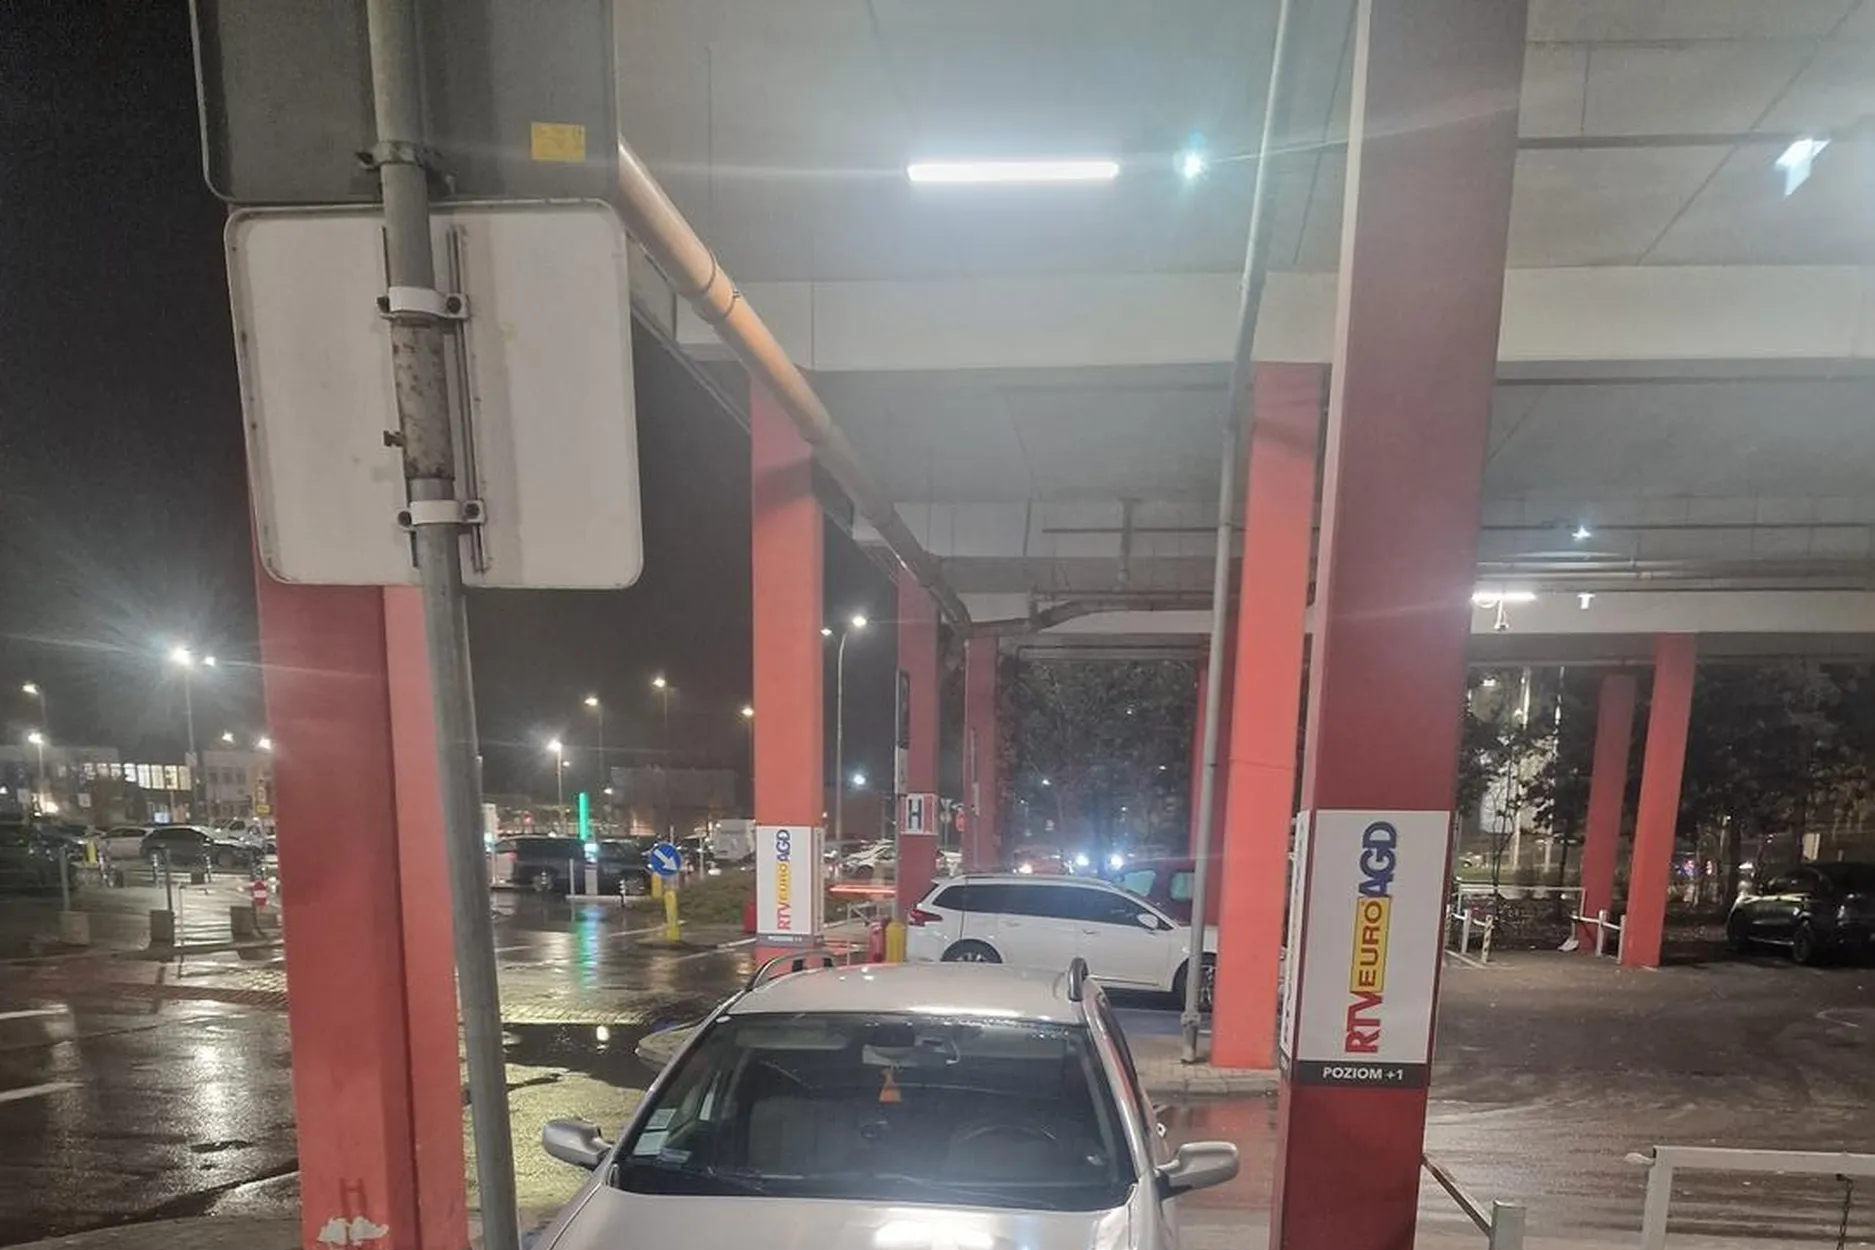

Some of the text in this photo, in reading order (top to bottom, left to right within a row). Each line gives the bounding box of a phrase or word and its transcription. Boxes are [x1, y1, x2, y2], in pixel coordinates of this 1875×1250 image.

[776, 829, 791, 862] AGD
[777, 902, 791, 931] RTV
[1345, 821, 1398, 1053] RTV EURO AGD
[1322, 1066, 1404, 1081] POZIOM +1
